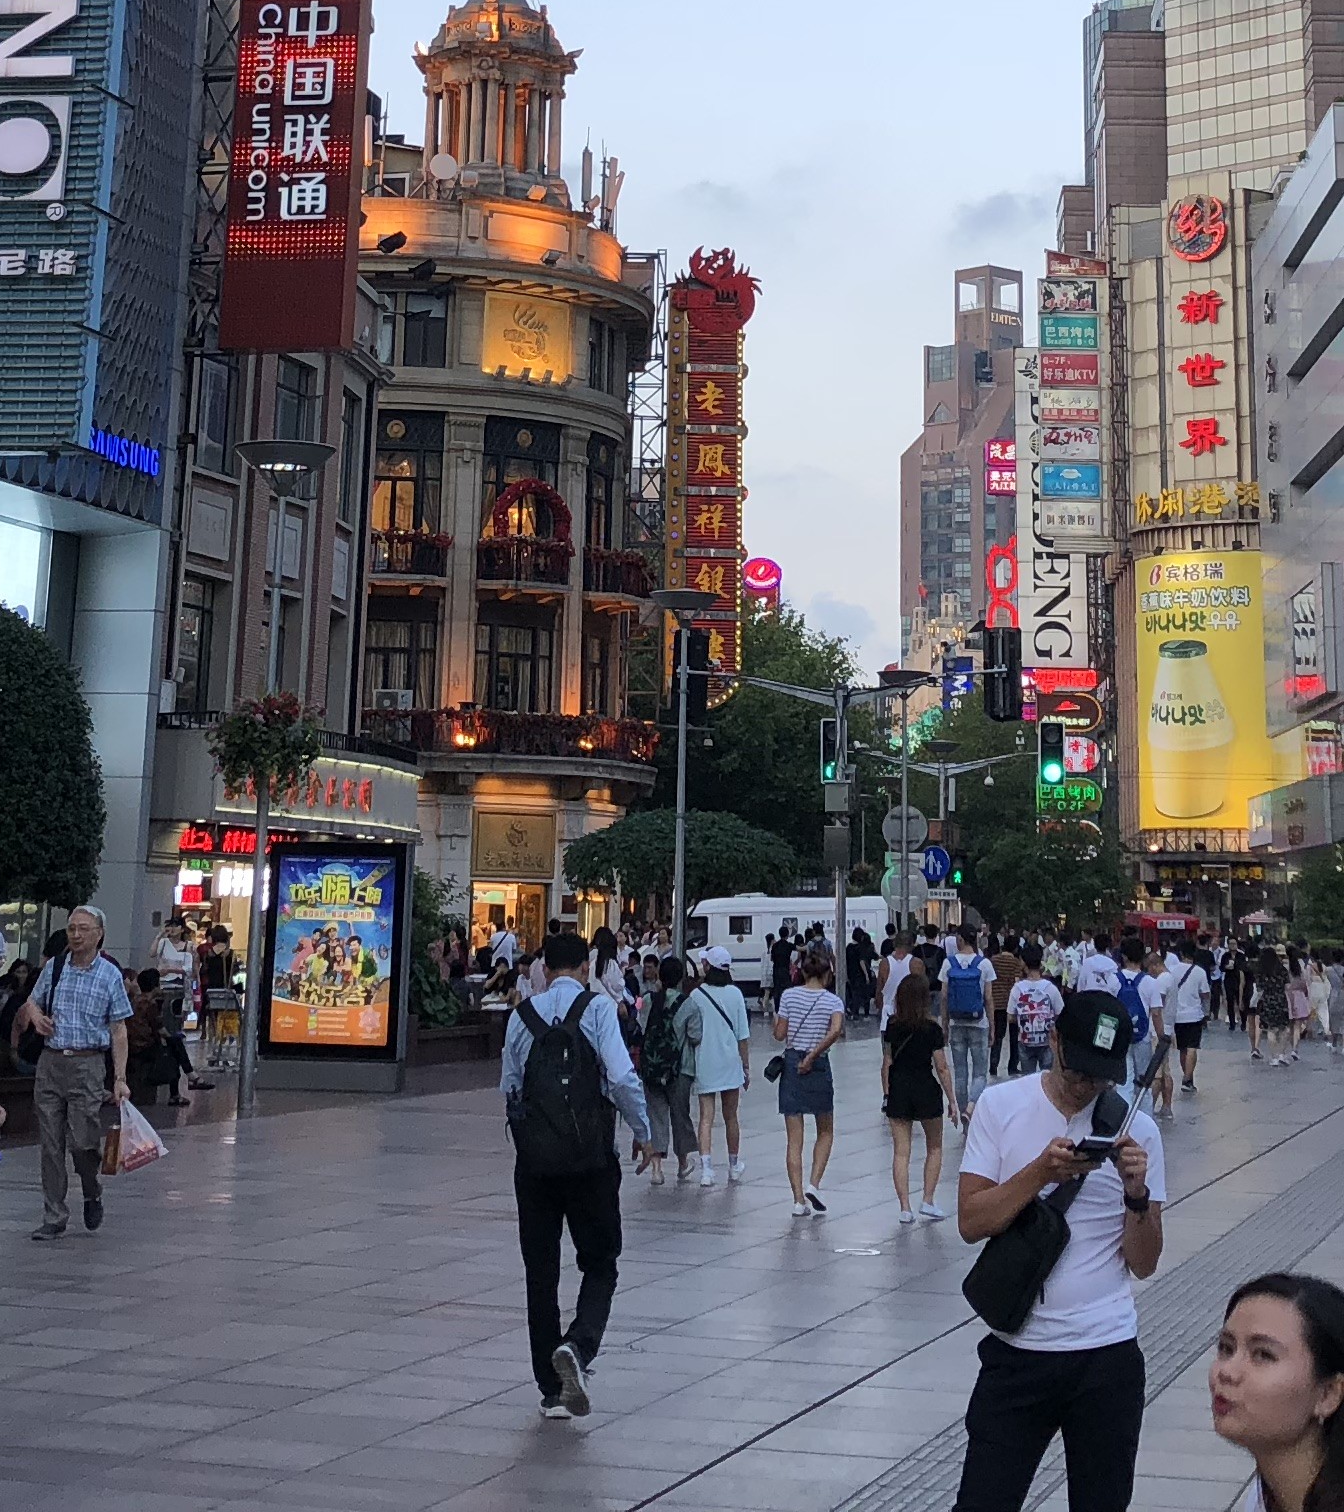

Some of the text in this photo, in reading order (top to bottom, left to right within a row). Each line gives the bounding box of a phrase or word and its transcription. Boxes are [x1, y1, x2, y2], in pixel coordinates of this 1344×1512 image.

[278, 0, 339, 221] 中国联通
[246, 103, 276, 222] unicom
[1045, 326, 1095, 338] 巴西烤肉
[1043, 368, 1097, 381] 好乐迪KTV
[1177, 290, 1228, 457] 新世界
[1165, 562, 1225, 583] 宾格瑞
[1140, 586, 1251, 613] 香蕉味牛奶饮料
